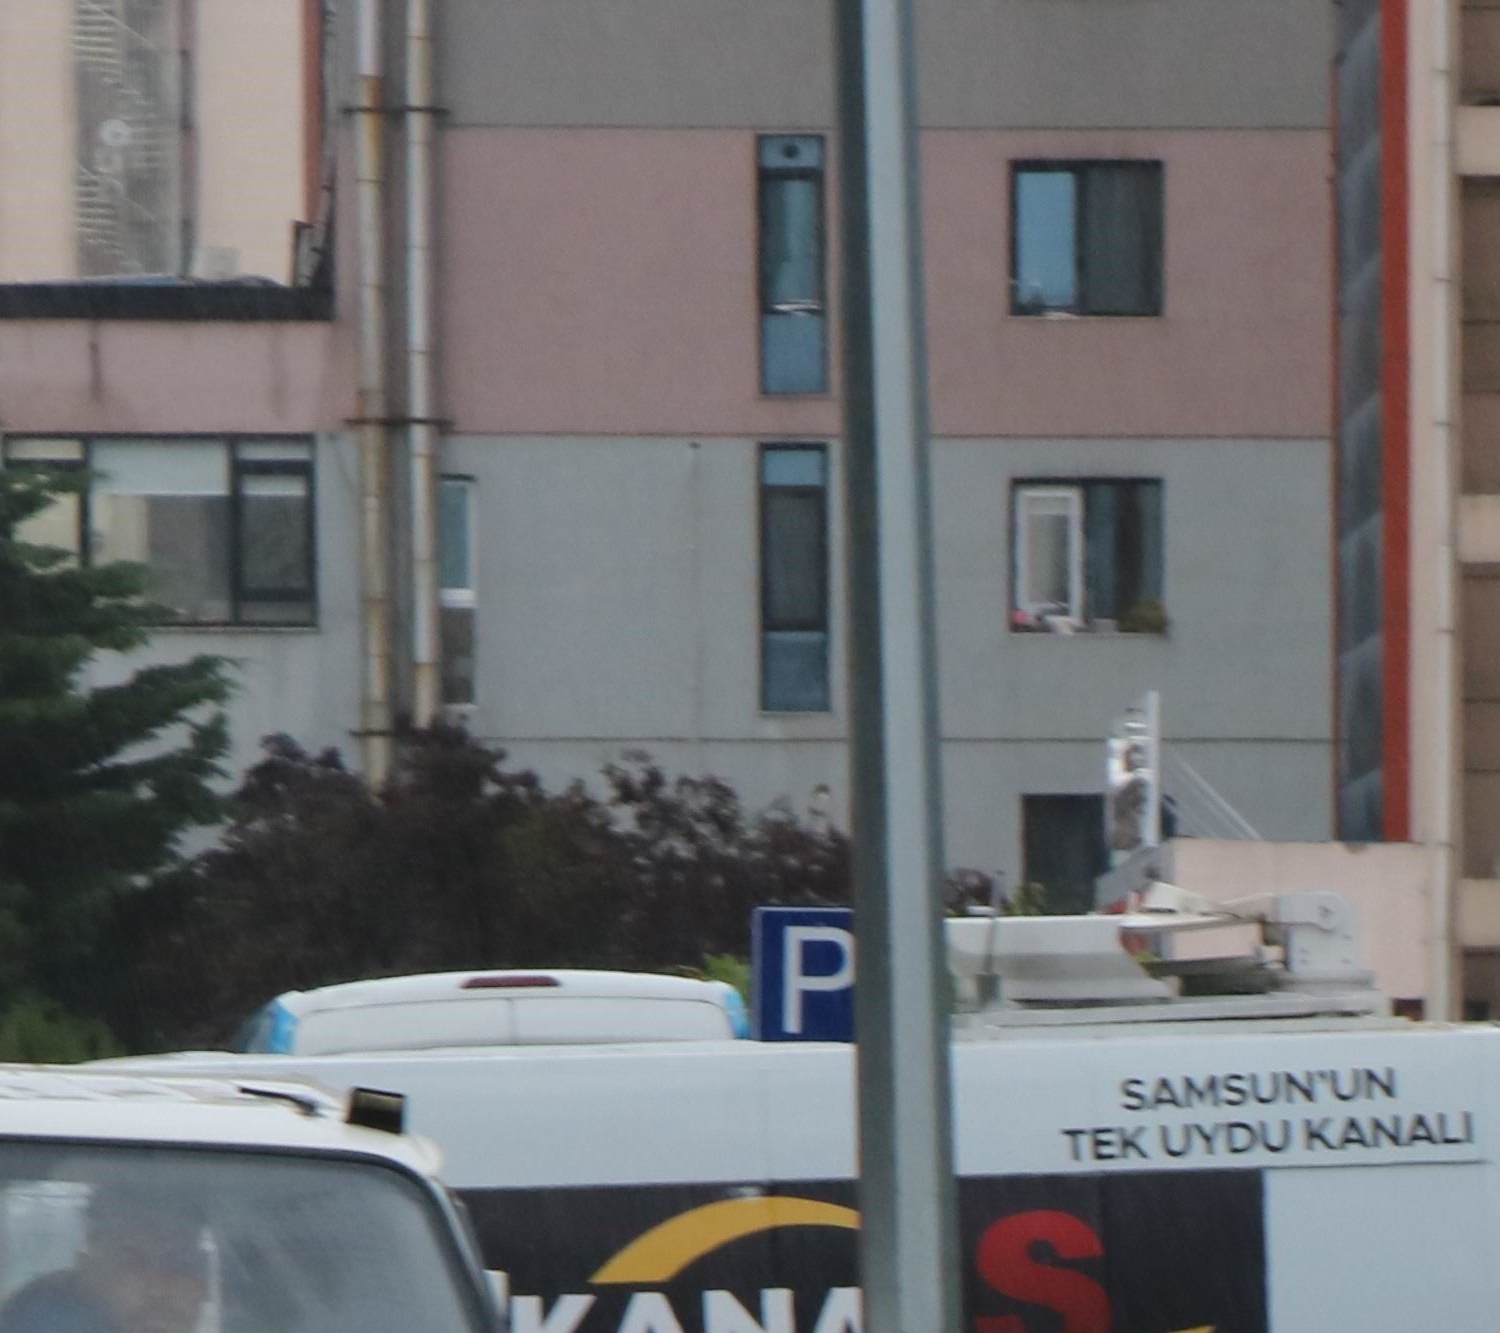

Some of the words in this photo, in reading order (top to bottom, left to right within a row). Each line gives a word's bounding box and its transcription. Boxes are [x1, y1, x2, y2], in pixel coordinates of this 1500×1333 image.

[782, 926, 857, 1034] P
[1120, 1067, 1396, 1112] SAMSUN'UN
[1062, 1126, 1148, 1160] TEK
[1160, 1118, 1292, 1157] UYDU
[1304, 1110, 1474, 1151] KANALI
